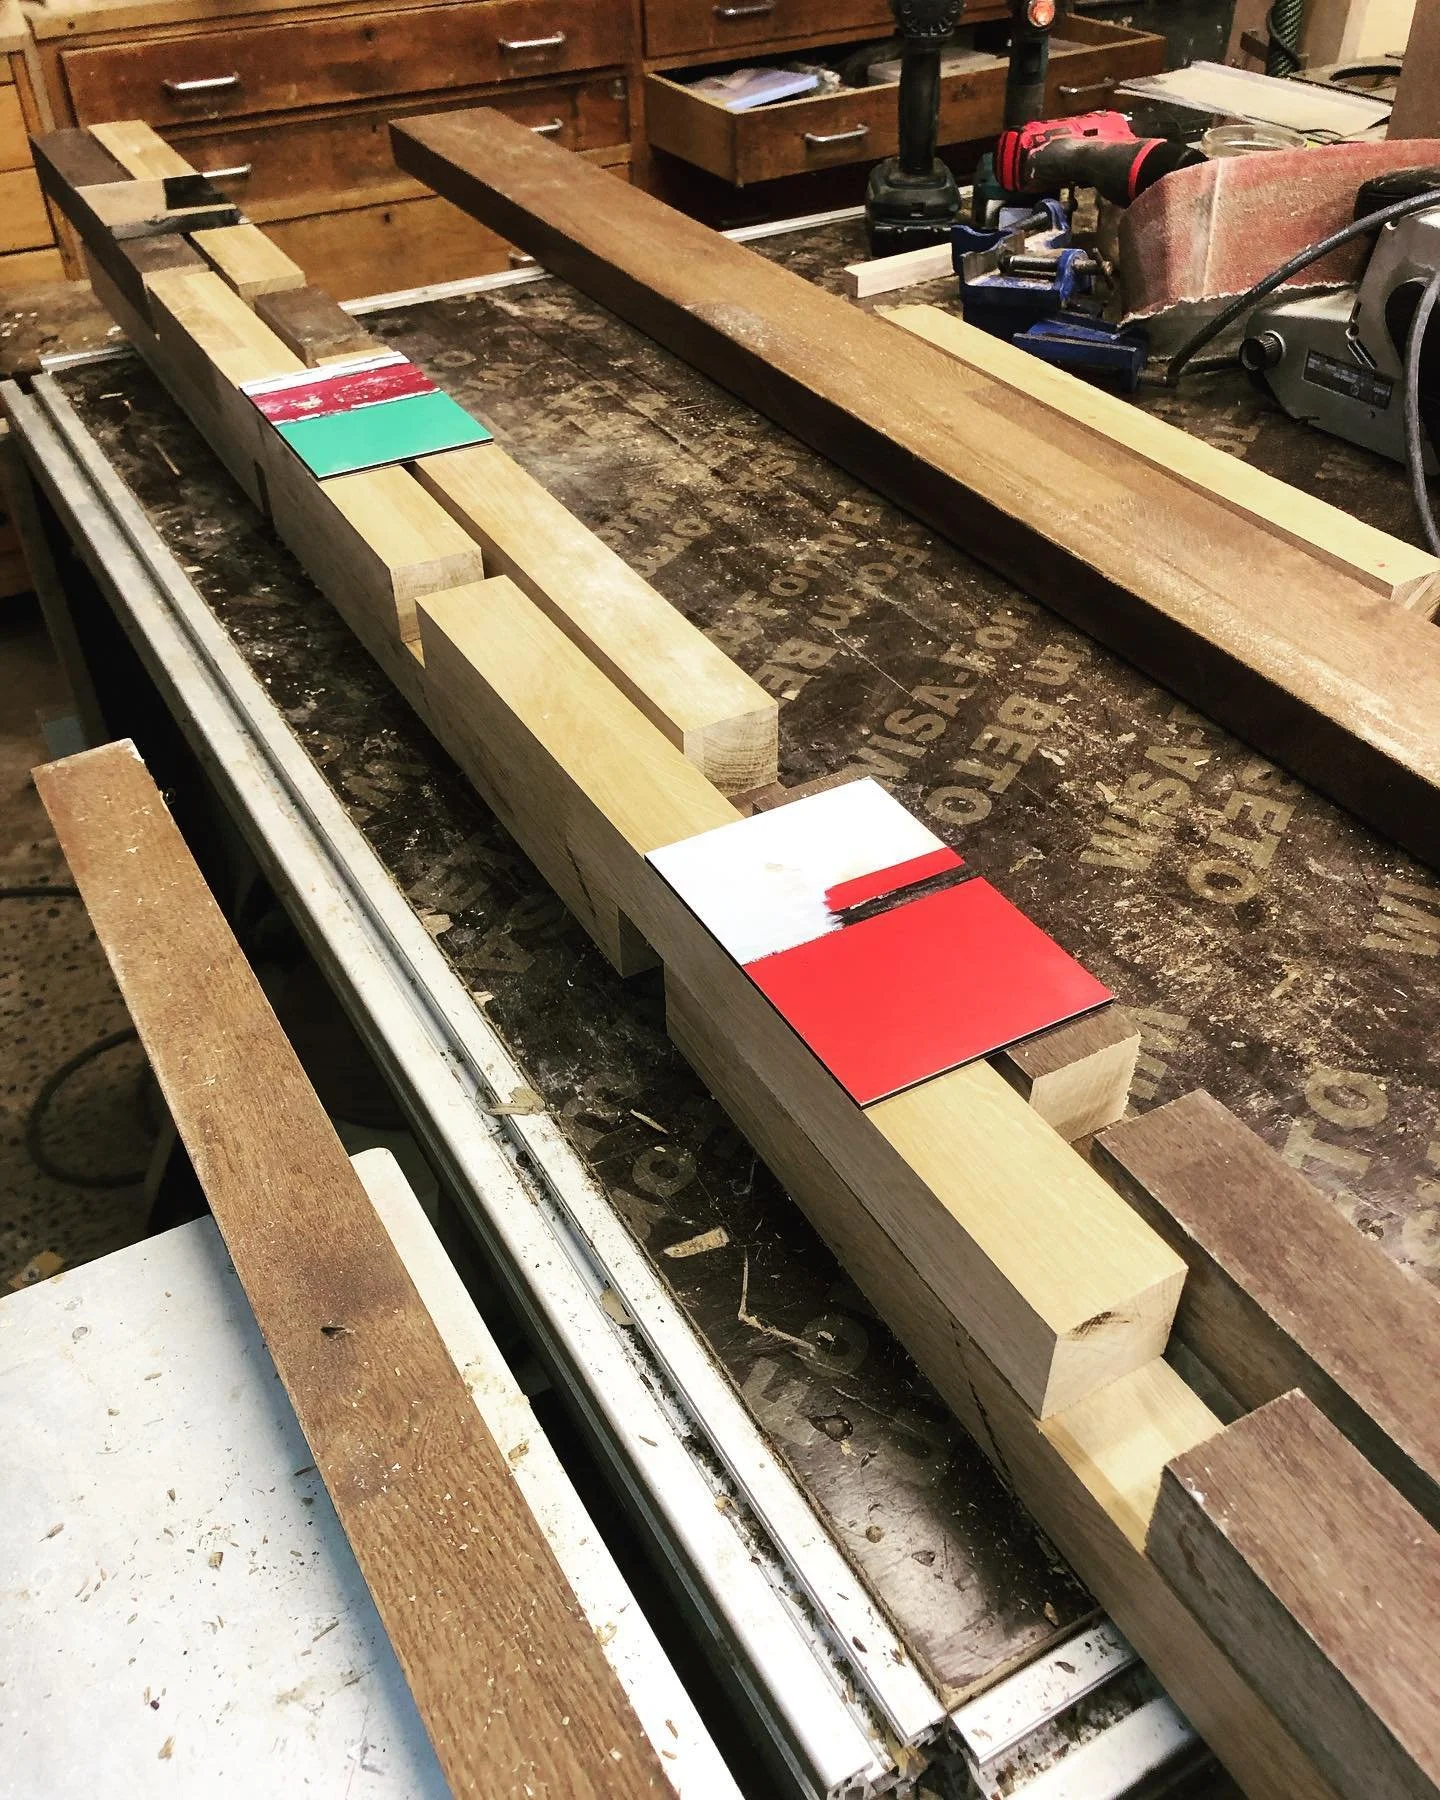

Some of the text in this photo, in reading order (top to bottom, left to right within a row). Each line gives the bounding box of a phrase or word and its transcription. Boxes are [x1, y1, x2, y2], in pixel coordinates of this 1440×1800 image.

[750, 636, 837, 708] BE
[923, 690, 1064, 827] BETO
[1284, 1066, 1389, 1177] TO
